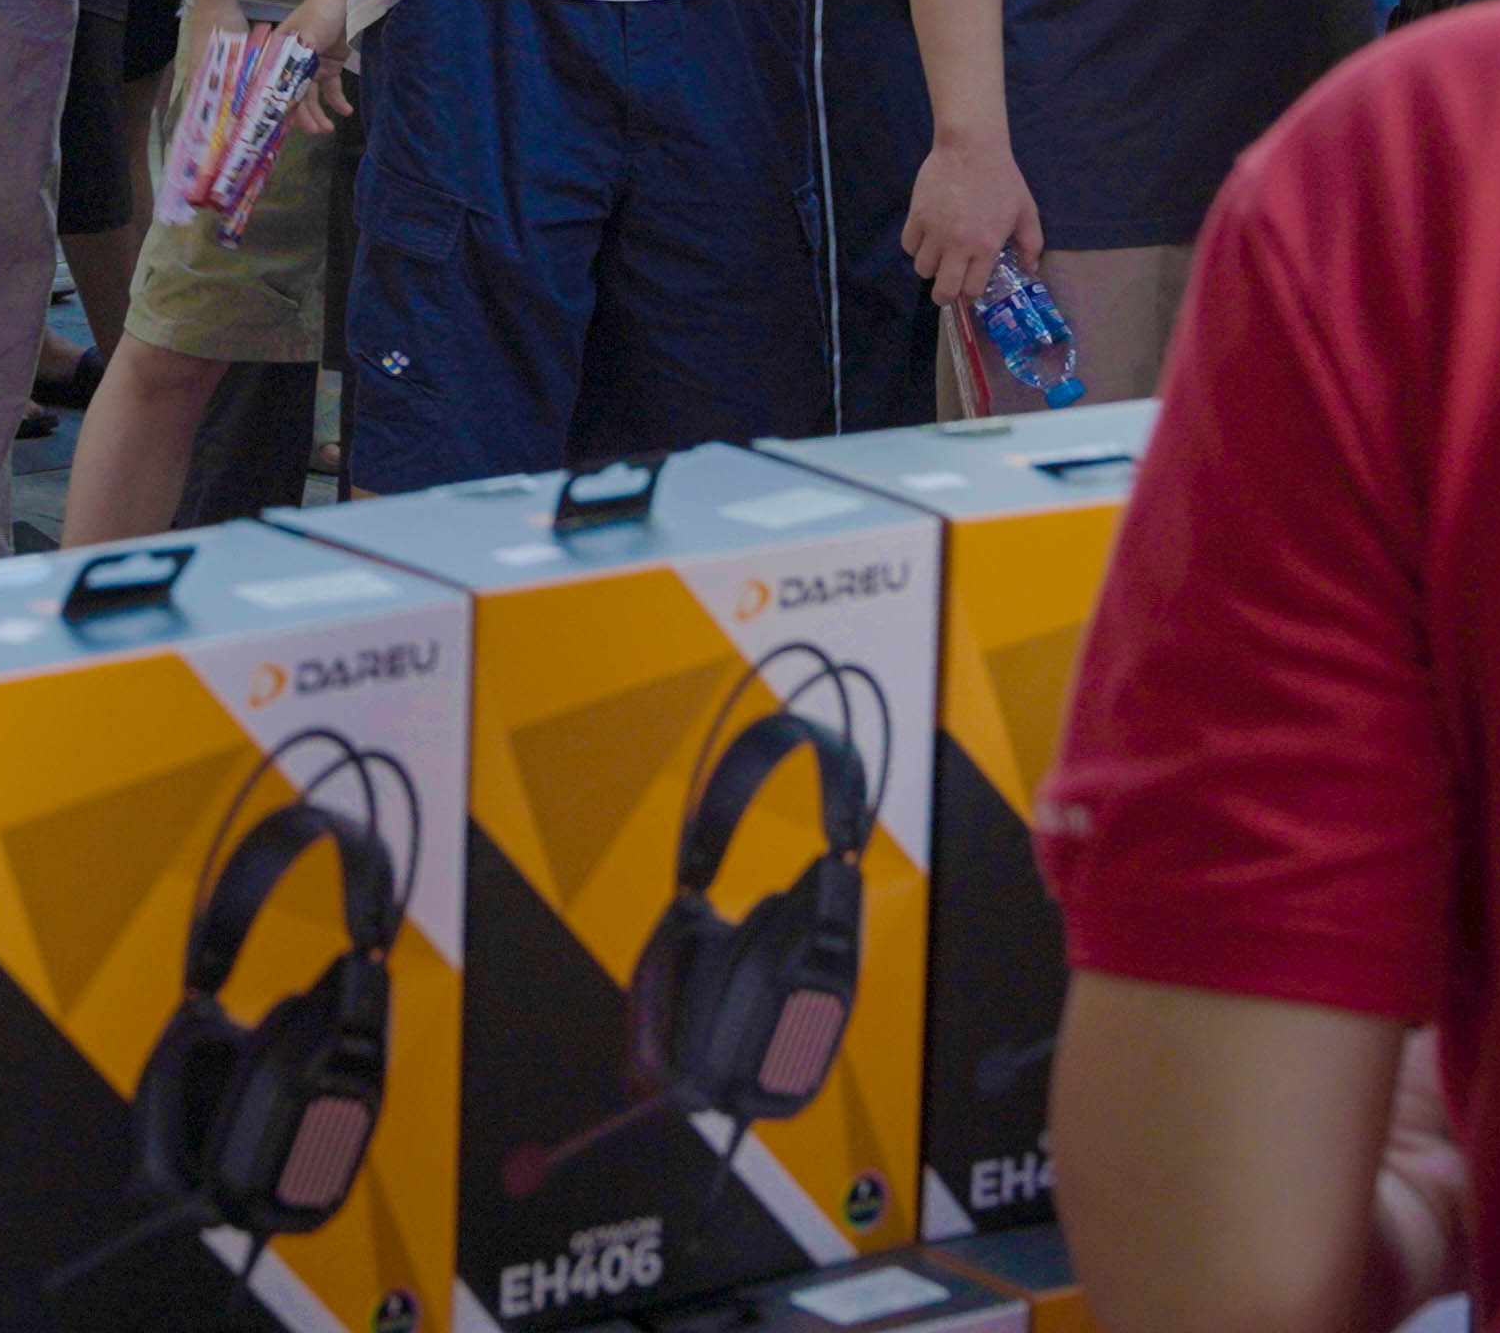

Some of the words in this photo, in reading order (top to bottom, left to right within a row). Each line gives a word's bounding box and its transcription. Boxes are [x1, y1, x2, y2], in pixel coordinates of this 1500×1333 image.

[777, 559, 912, 611] DAREU
[294, 638, 442, 697] DAREU
[500, 1237, 664, 1320] EH406
